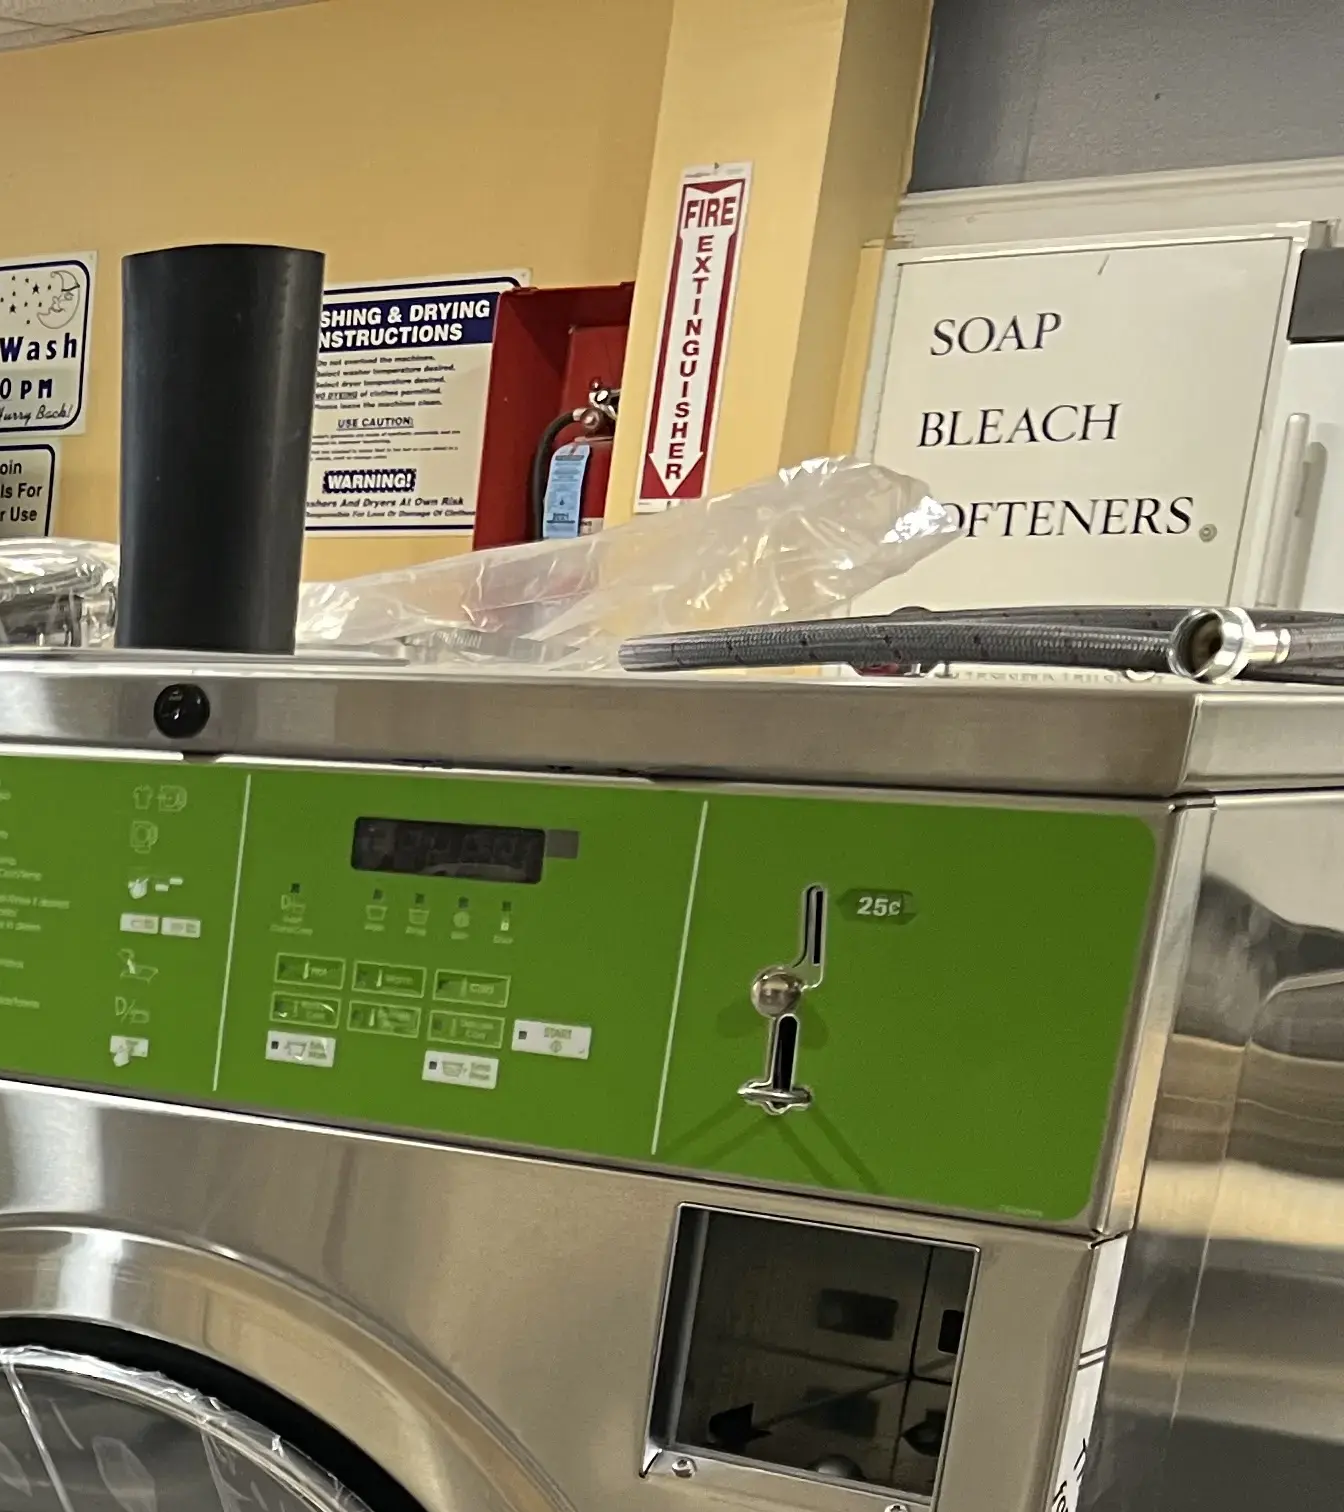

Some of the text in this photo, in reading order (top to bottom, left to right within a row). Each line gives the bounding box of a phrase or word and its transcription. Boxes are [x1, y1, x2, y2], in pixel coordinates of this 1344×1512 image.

[683, 196, 736, 229] FIRE
[320, 299, 490, 327] SHING & DRYING
[0, 332, 77, 363] Wash
[319, 323, 463, 348] NSTRUCTIONS
[930, 312, 1061, 356] SOAP
[665, 235, 714, 480] EXTINGUISHER
[337, 418, 358, 428] USE
[917, 403, 1122, 448] BLEACH
[0, 484, 12, 499] Is
[17, 482, 43, 498] For
[328, 473, 411, 490] WARNING!
[10, 506, 37, 522] Use
[340, 498, 360, 507] And
[363, 497, 396, 508] Dryers
[399, 497, 411, 506] At
[415, 497, 438, 506] Own
[441, 497, 464, 506] Risk
[941, 496, 1194, 538] OFTENERS
